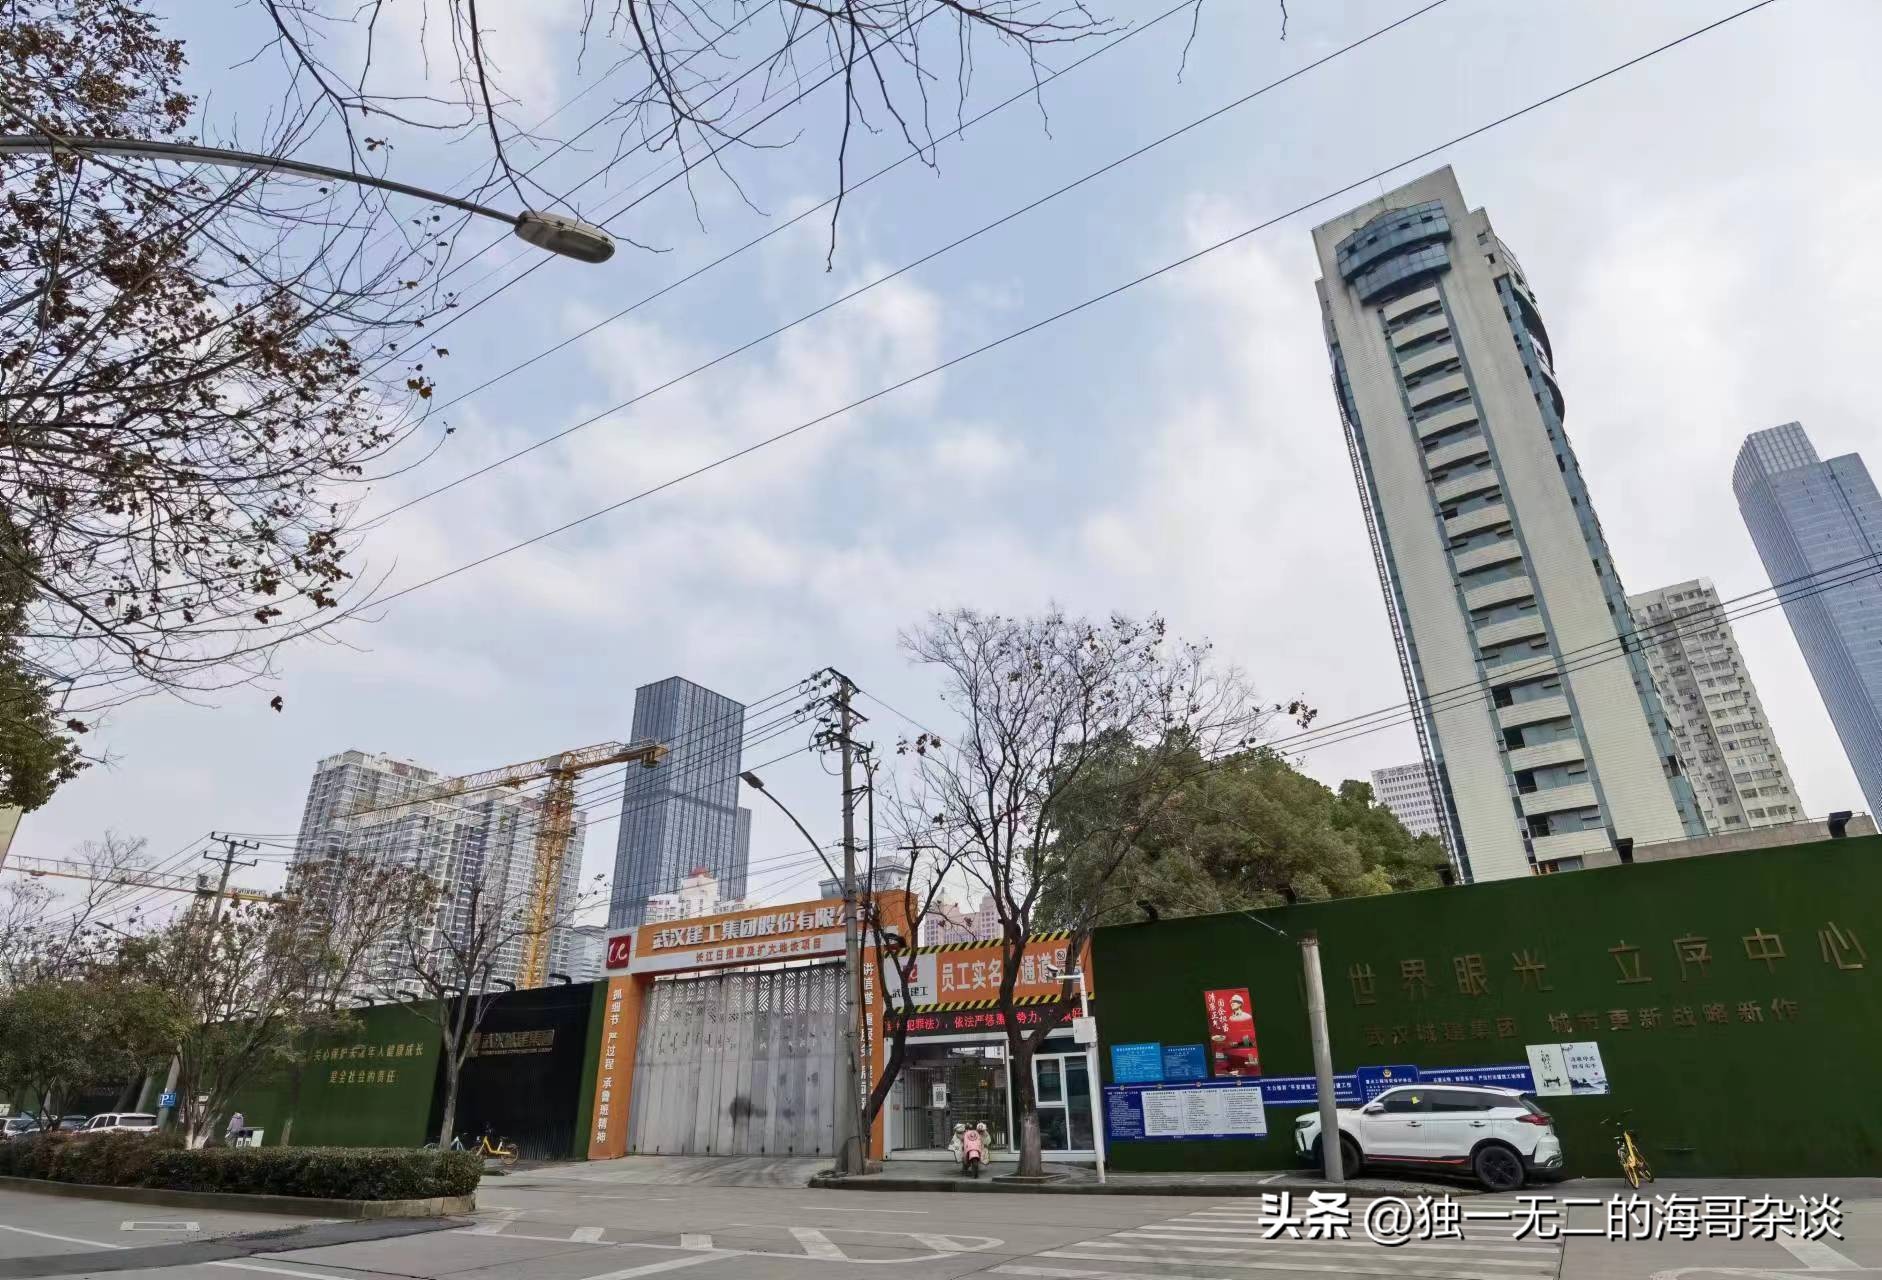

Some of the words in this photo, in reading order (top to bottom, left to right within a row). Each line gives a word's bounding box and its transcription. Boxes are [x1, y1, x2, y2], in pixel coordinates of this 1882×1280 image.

[1348, 948, 1552, 1006] 世界眼光
[1608, 921, 1867, 983] 立序中心
[160, 1094, 169, 1105] P
